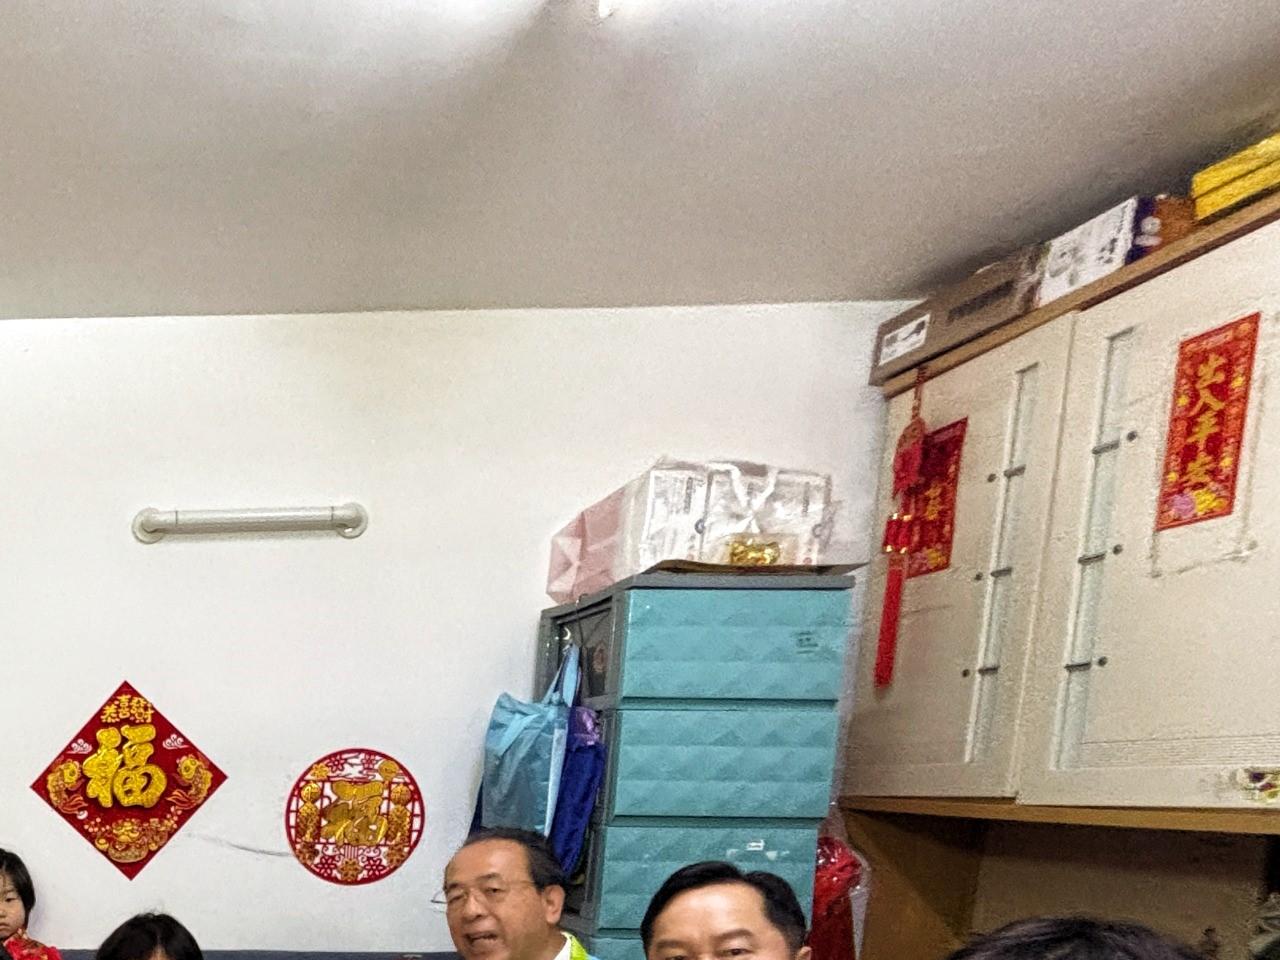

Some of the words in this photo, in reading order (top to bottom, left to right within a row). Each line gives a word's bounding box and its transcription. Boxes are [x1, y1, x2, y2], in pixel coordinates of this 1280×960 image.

[100, 694, 154, 723] 恭喜發財
[82, 723, 167, 809] 福
[320, 780, 388, 847] 福
